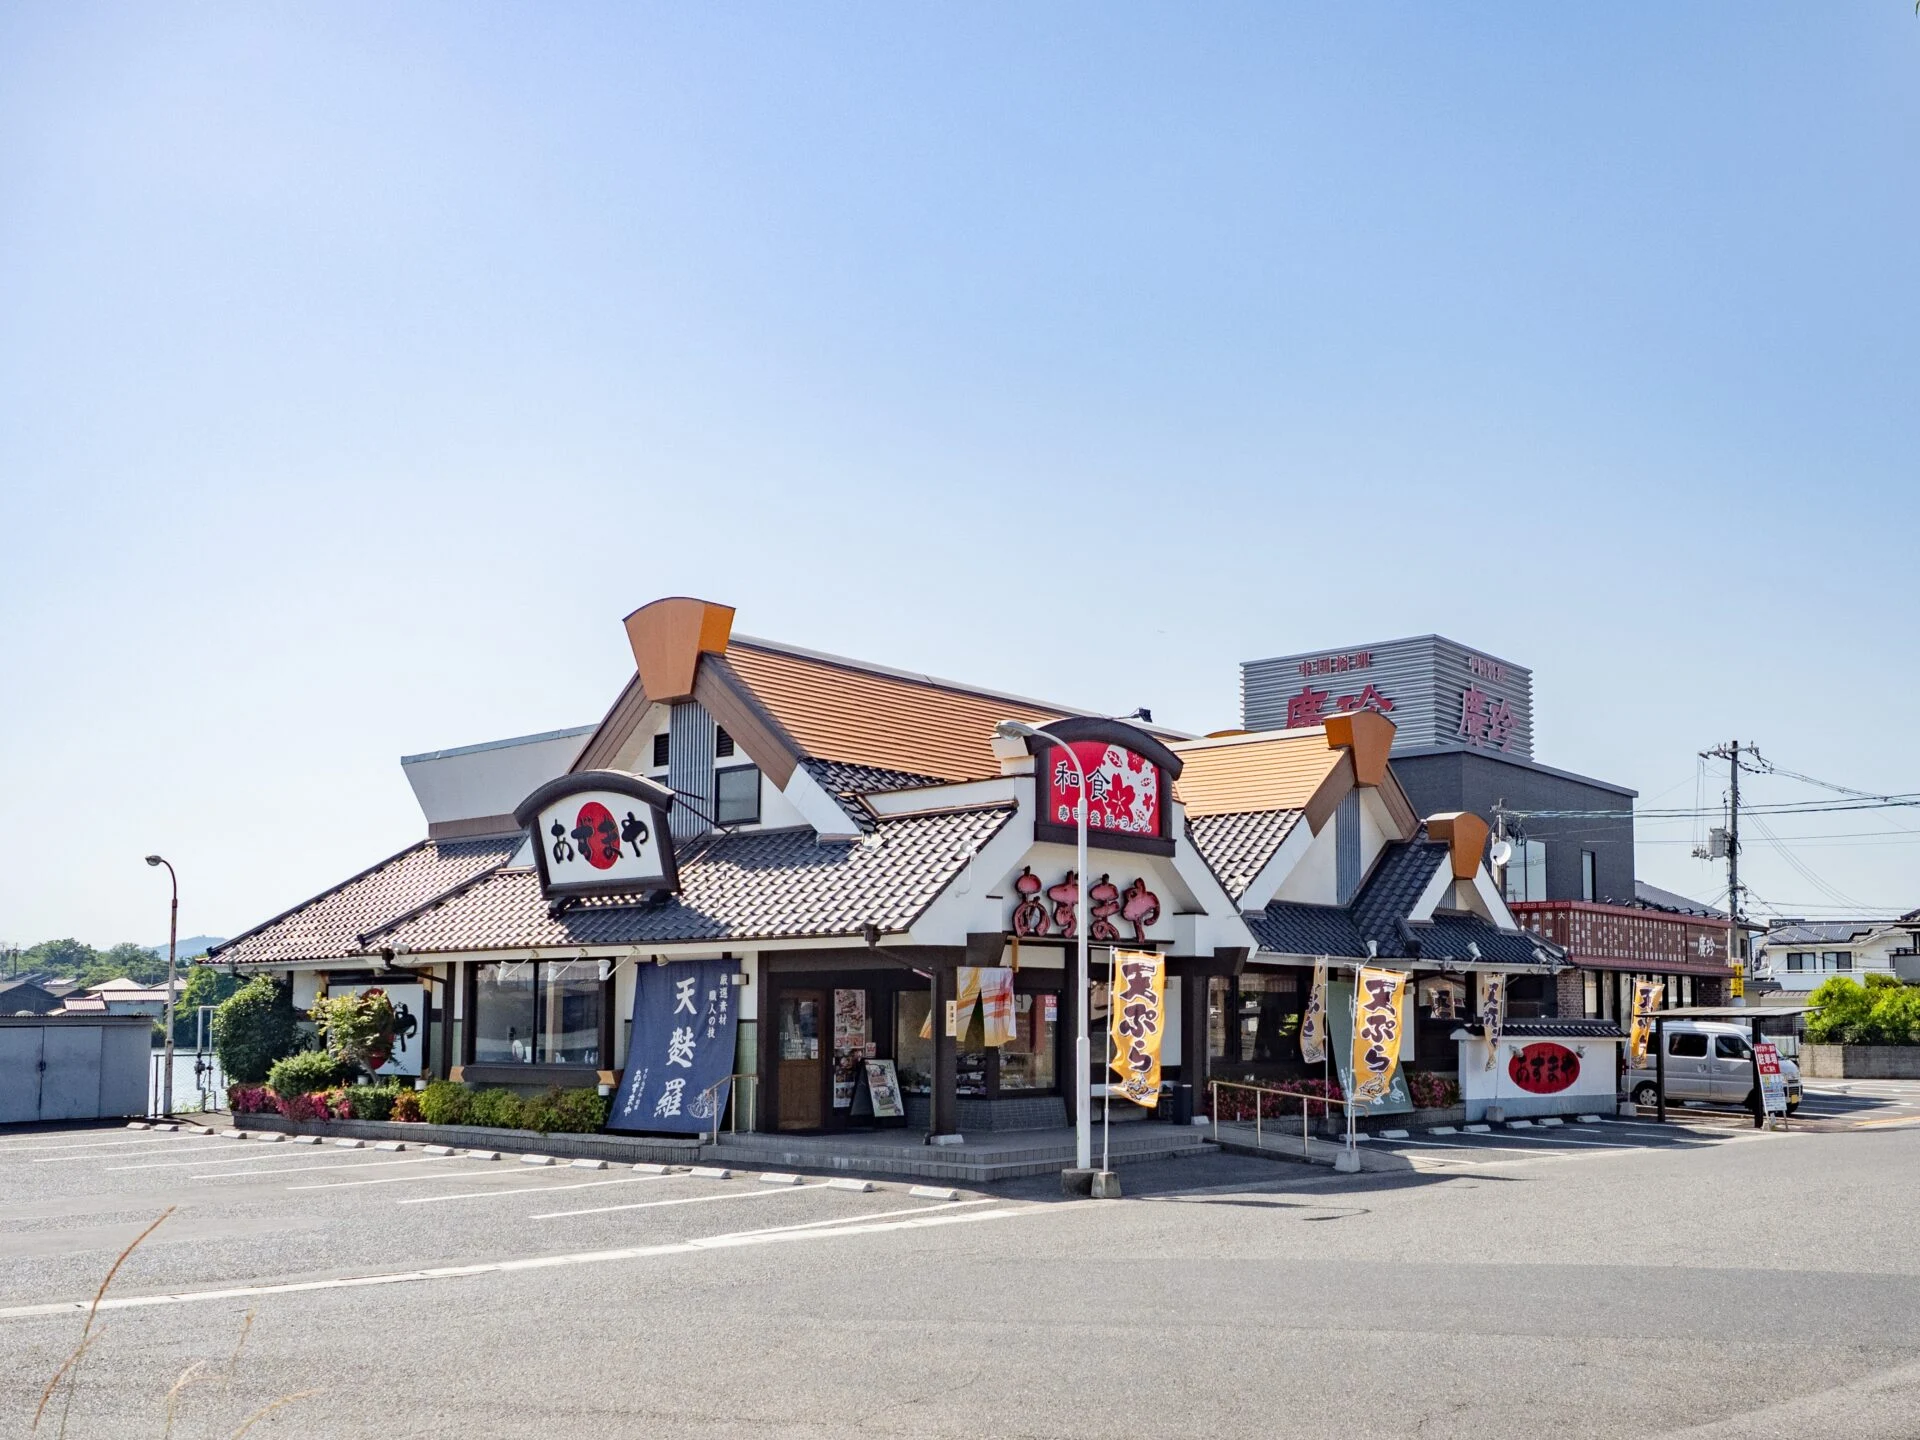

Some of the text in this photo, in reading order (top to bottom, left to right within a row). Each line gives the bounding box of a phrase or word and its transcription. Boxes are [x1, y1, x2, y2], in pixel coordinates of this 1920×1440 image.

[1055, 761, 1111, 801] 和食
[653, 977, 697, 1118] 天麩羅
[1119, 963, 1157, 1072] 天ぷら
[1362, 979, 1396, 1072] 天ぷら
